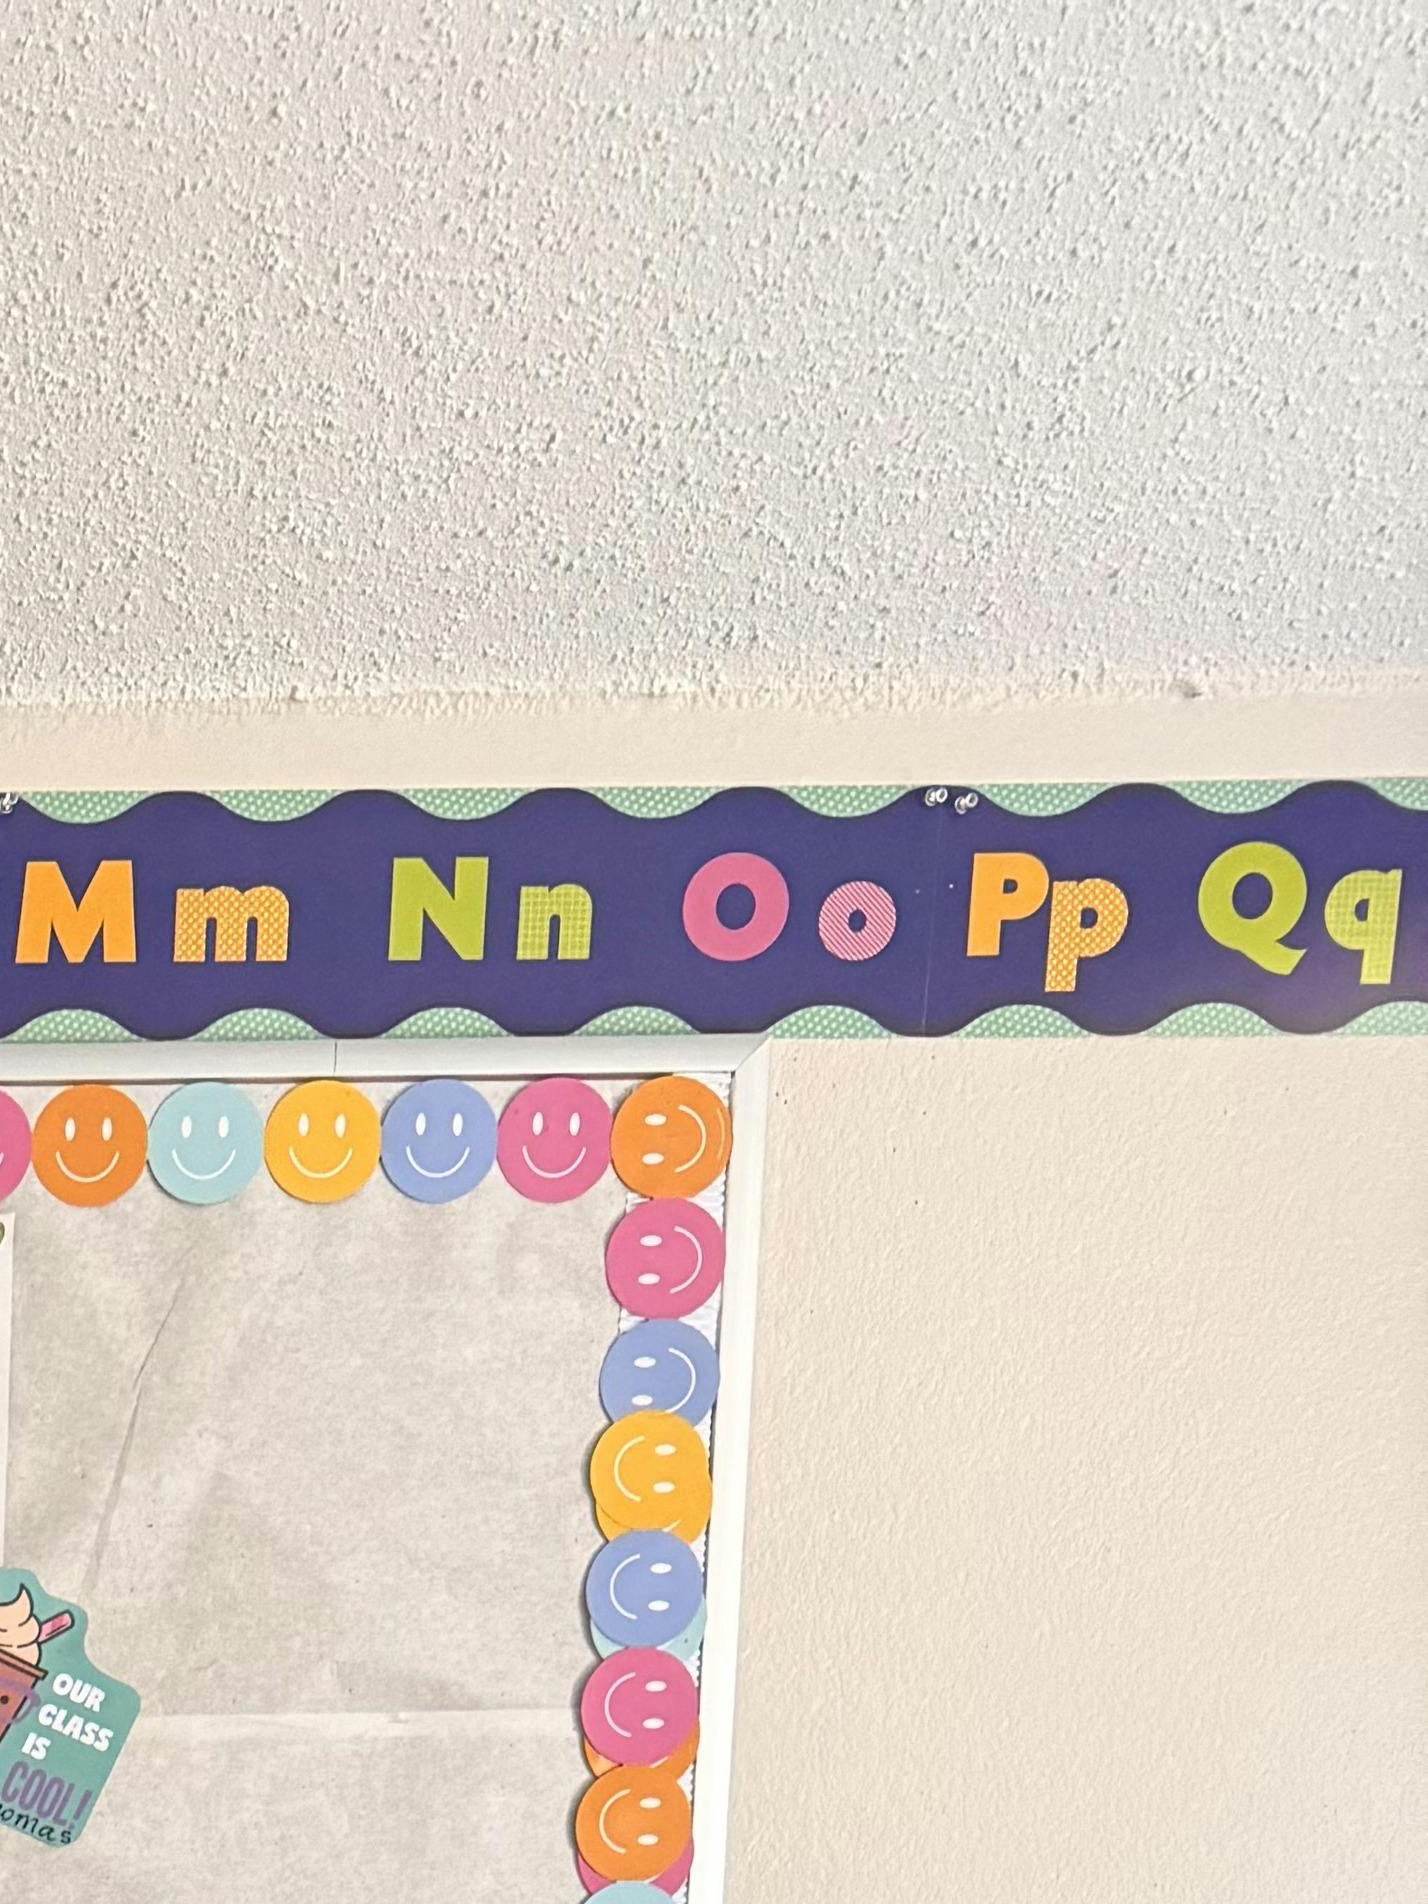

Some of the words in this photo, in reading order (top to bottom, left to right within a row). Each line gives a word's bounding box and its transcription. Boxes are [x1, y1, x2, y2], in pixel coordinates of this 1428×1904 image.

[388, 858, 592, 962] Nn
[681, 855, 895, 962] Oo
[966, 851, 1128, 993] Pp
[1199, 843, 1401, 984] Qq
[52, 1673, 105, 1712] OUR
[21, 1732, 51, 1760] IS
[38, 1704, 114, 1751] CLASS
[1, 1761, 92, 1831] COOL!
